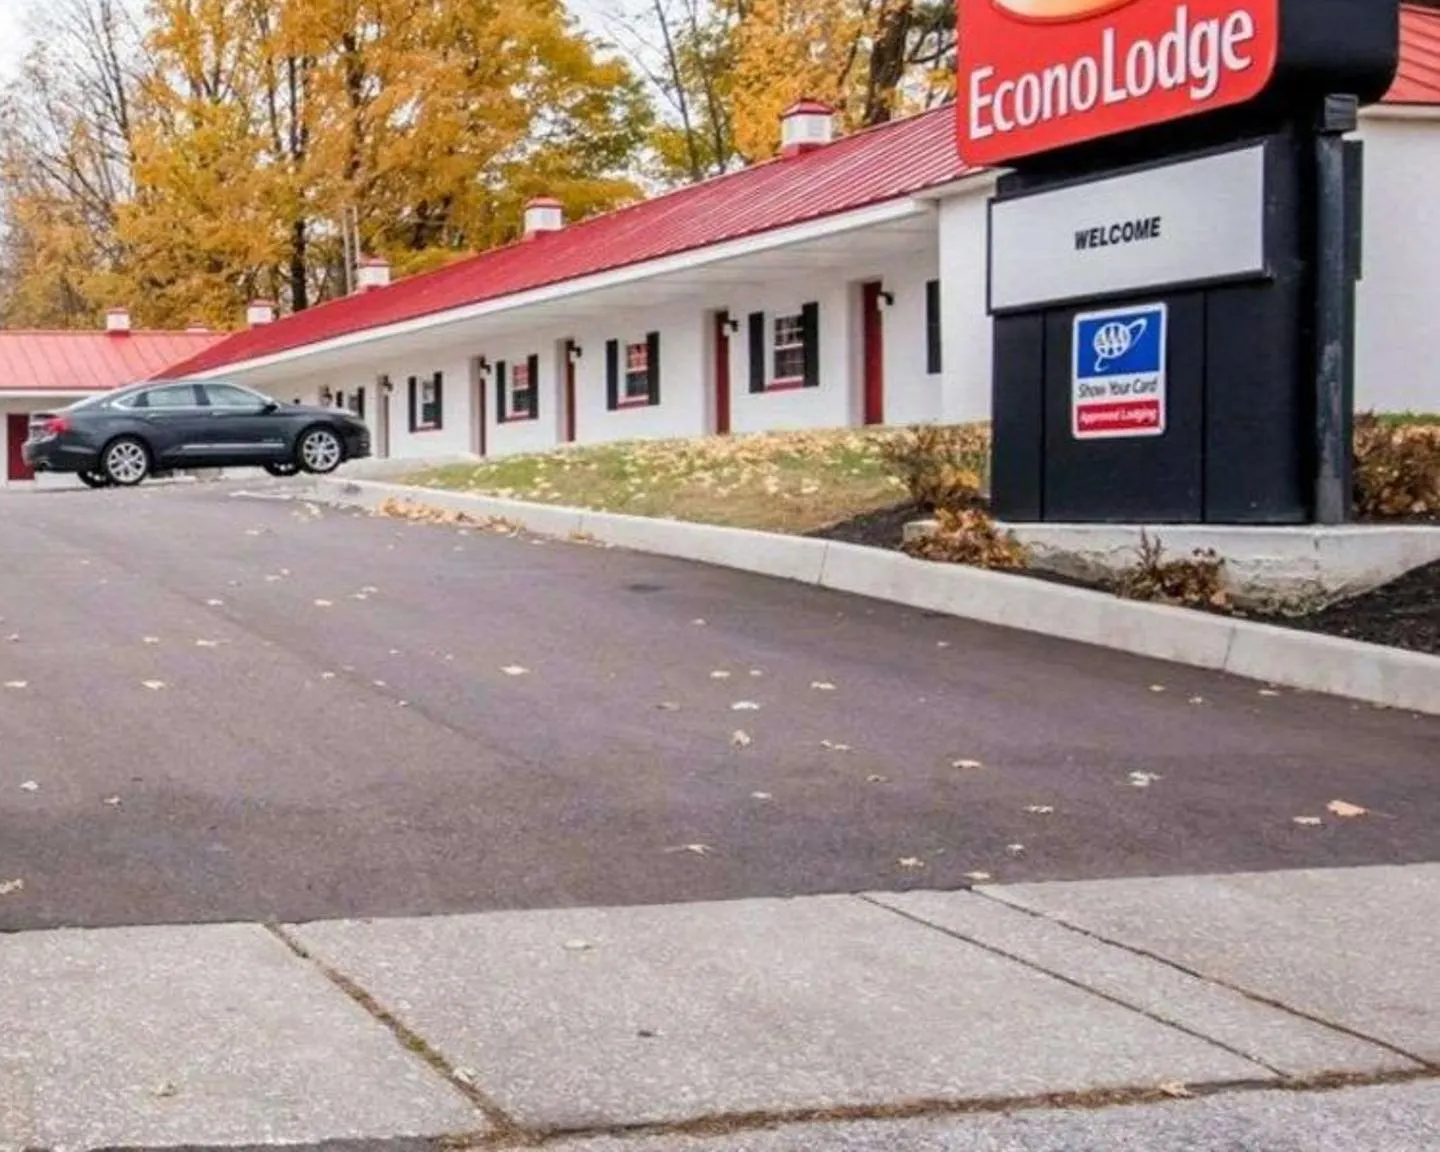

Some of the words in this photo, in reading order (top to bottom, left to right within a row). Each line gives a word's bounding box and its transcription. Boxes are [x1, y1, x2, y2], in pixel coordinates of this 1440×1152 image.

[969, 4, 1255, 141] EconoLodge
[1073, 216, 1162, 250] WELCOME
[1078, 383, 1106, 399] Show
[1109, 380, 1131, 396] Your
[1133, 377, 1157, 394] Card
[1120, 407, 1157, 423] Lodging
